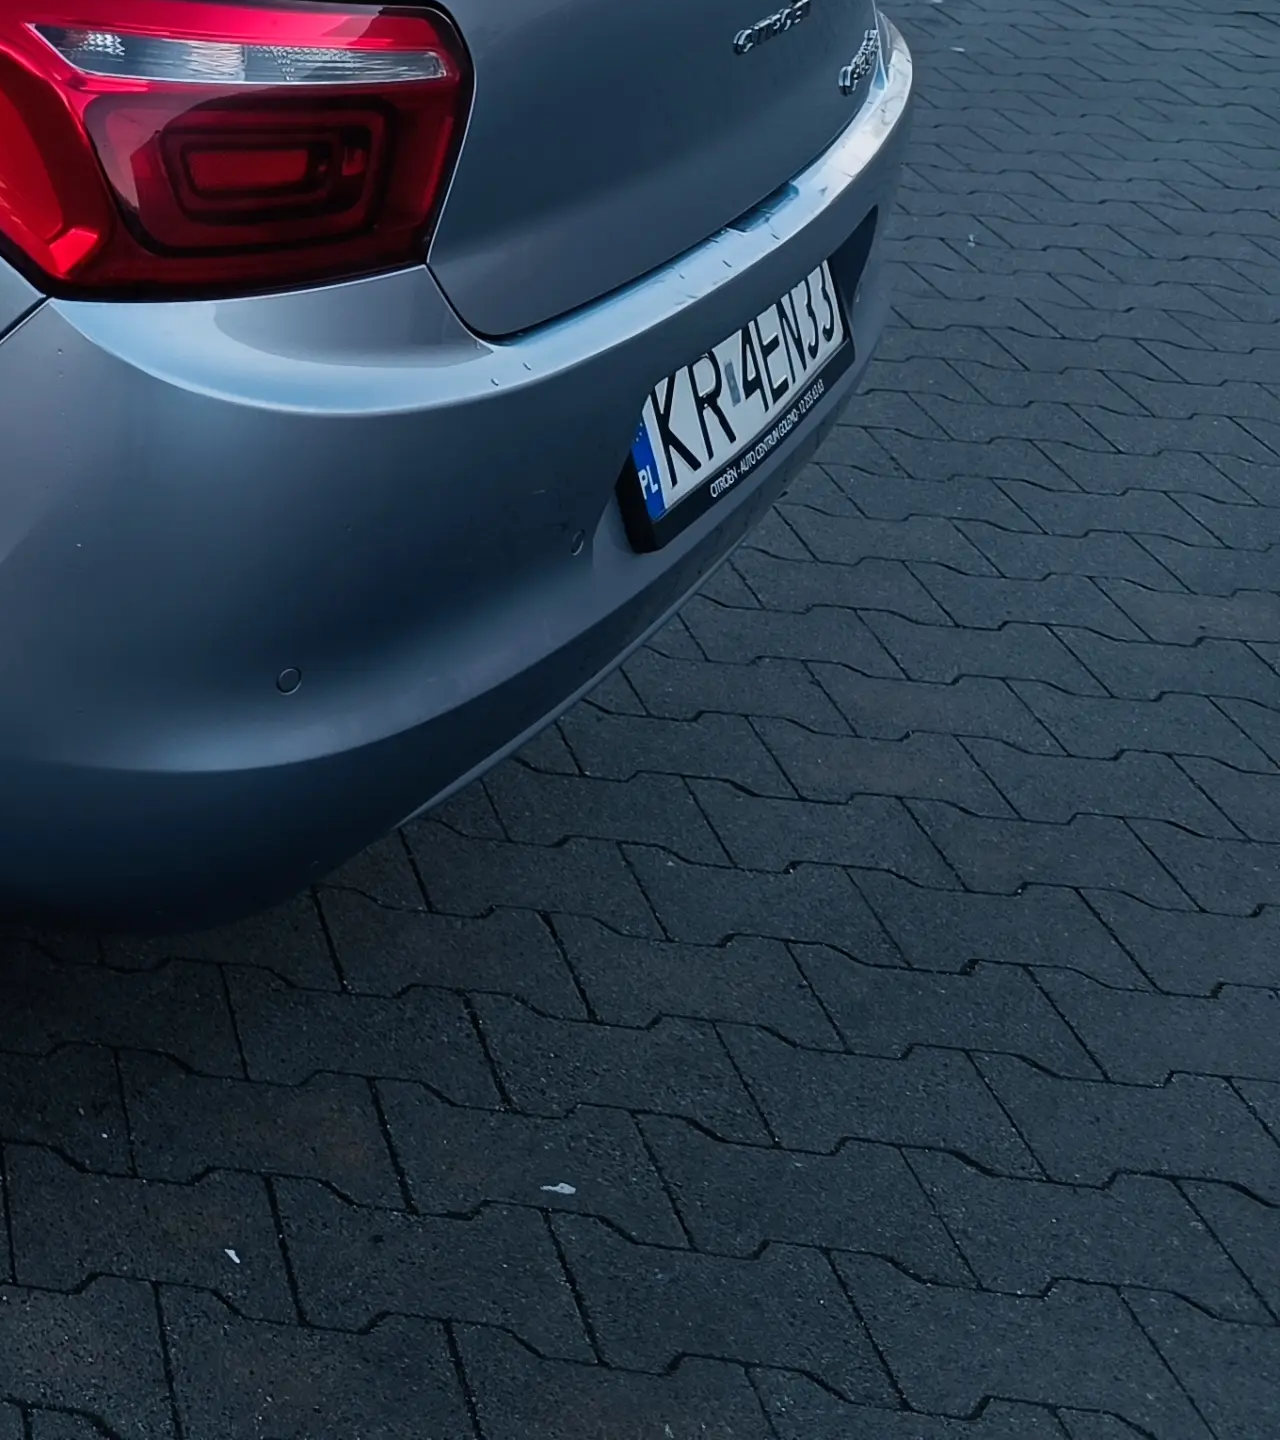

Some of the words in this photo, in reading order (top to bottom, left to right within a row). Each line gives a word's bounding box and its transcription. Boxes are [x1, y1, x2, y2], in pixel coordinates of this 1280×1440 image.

[651, 347, 737, 489] KR
[740, 261, 836, 413] 4EN33
[638, 471, 659, 501] PL
[710, 466, 738, 497] CITROËN
[740, 450, 756, 474] AUTO
[755, 427, 781, 460] CENTRUM
